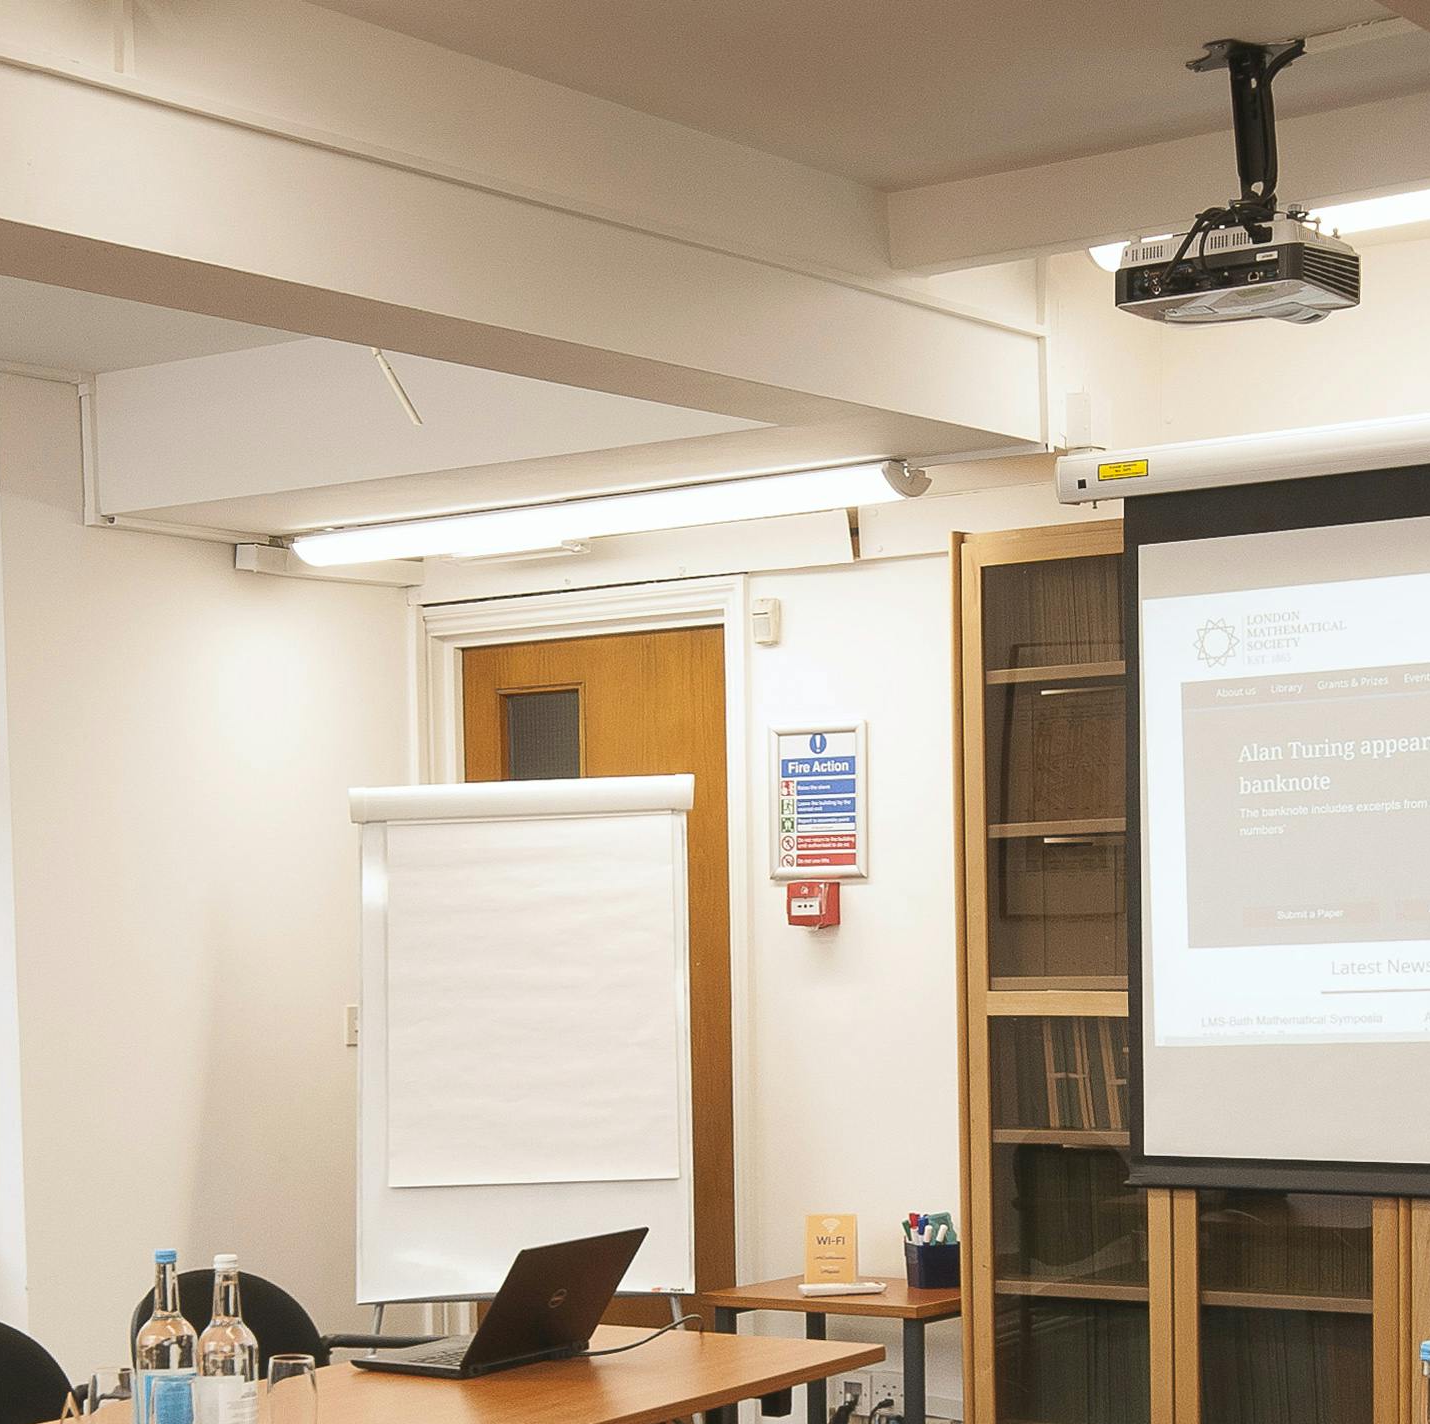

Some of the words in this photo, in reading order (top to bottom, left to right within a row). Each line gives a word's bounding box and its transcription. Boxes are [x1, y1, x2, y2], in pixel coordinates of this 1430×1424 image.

[1247, 610, 1300, 626] LONDON
[1247, 620, 1348, 638] MATHEMATICAL
[1246, 636, 1300, 652] SOCIETY
[1271, 682, 1303, 695] Library
[1317, 679, 1348, 691] Grants
[1350, 678, 1358, 689] &
[1360, 675, 1389, 688] Prizes
[1216, 687, 1243, 698] About
[1244, 687, 1257, 696] us
[1239, 740, 1283, 762] Alan
[1287, 737, 1355, 760] Turing
[788, 762, 811, 774] Fire
[812, 760, 849, 772] Action
[1239, 773, 1331, 795] banknote
[1239, 808, 1259, 819] The
[1261, 805, 1309, 817] banknote
[1311, 803, 1354, 815] includes
[1356, 800, 1401, 814] excerpts
[1404, 798, 1428, 809] from
[1277, 909, 1308, 921] Submit
[1317, 907, 1344, 920] Paper
[1330, 957, 1382, 977] Latest
[1201, 1015, 1253, 1027] LMS-Bath
[1256, 1014, 1326, 1026] Mathematical
[1330, 1013, 1383, 1026] Symposia
[816, 1236, 845, 1245] WI-FI
